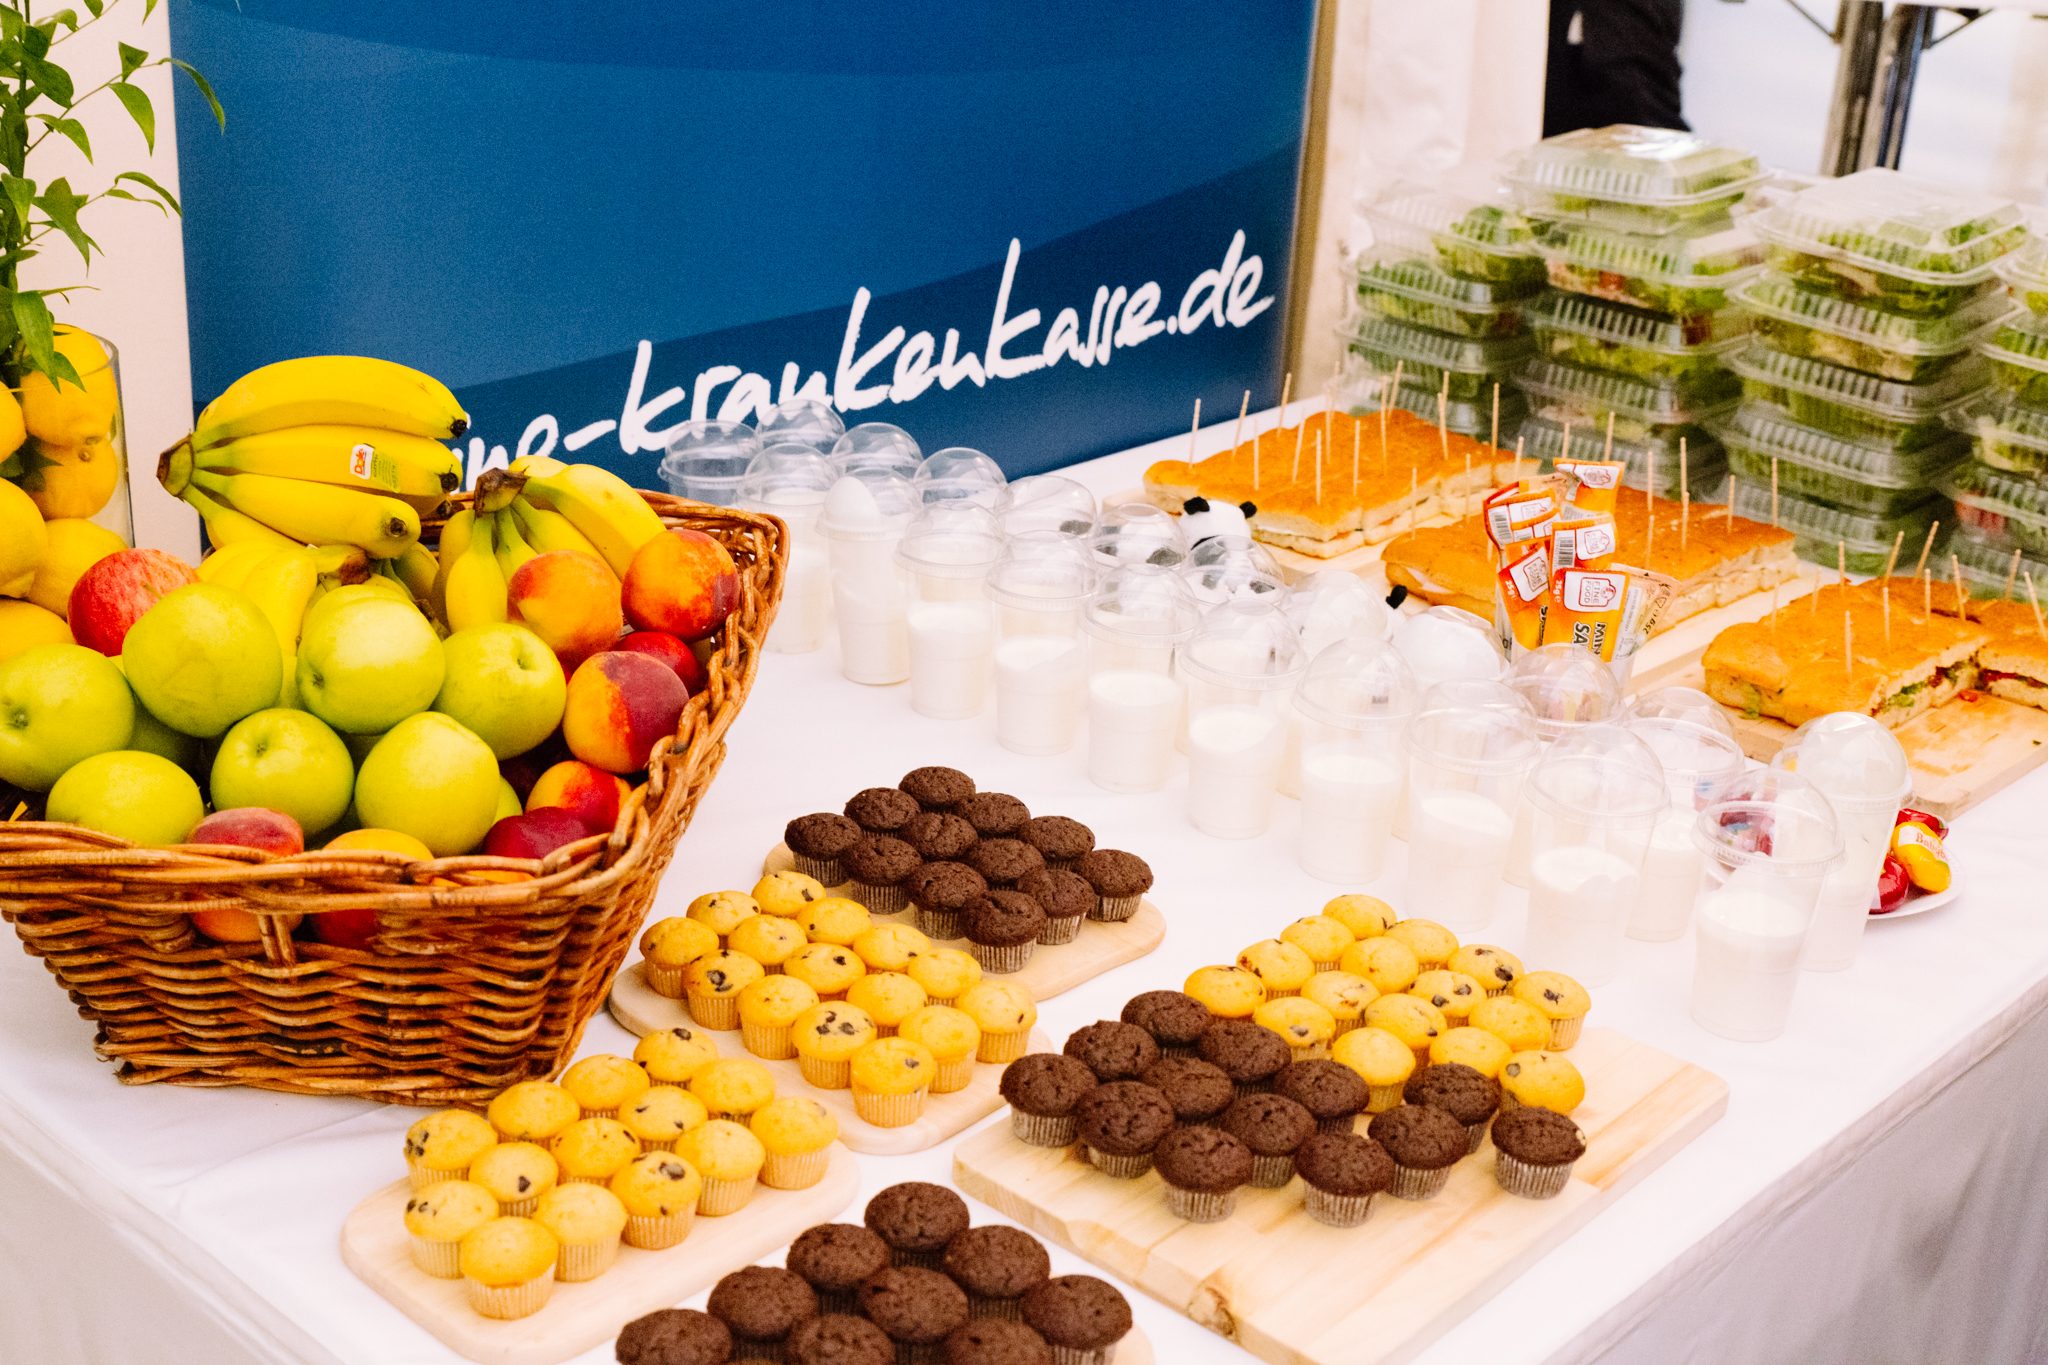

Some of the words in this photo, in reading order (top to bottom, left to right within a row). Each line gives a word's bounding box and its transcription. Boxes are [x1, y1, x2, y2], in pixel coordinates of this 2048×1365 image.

[354, 448, 365, 475] Dole
[1553, 580, 1563, 595] 25g
[1584, 580, 1592, 604] FOOD
[1593, 580, 1601, 604] FINE
[1572, 621, 1592, 645] SA
[1643, 618, 1656, 635] 25g
[1593, 622, 1607, 656] MIN
[1916, 832, 1948, 861] Babyb
